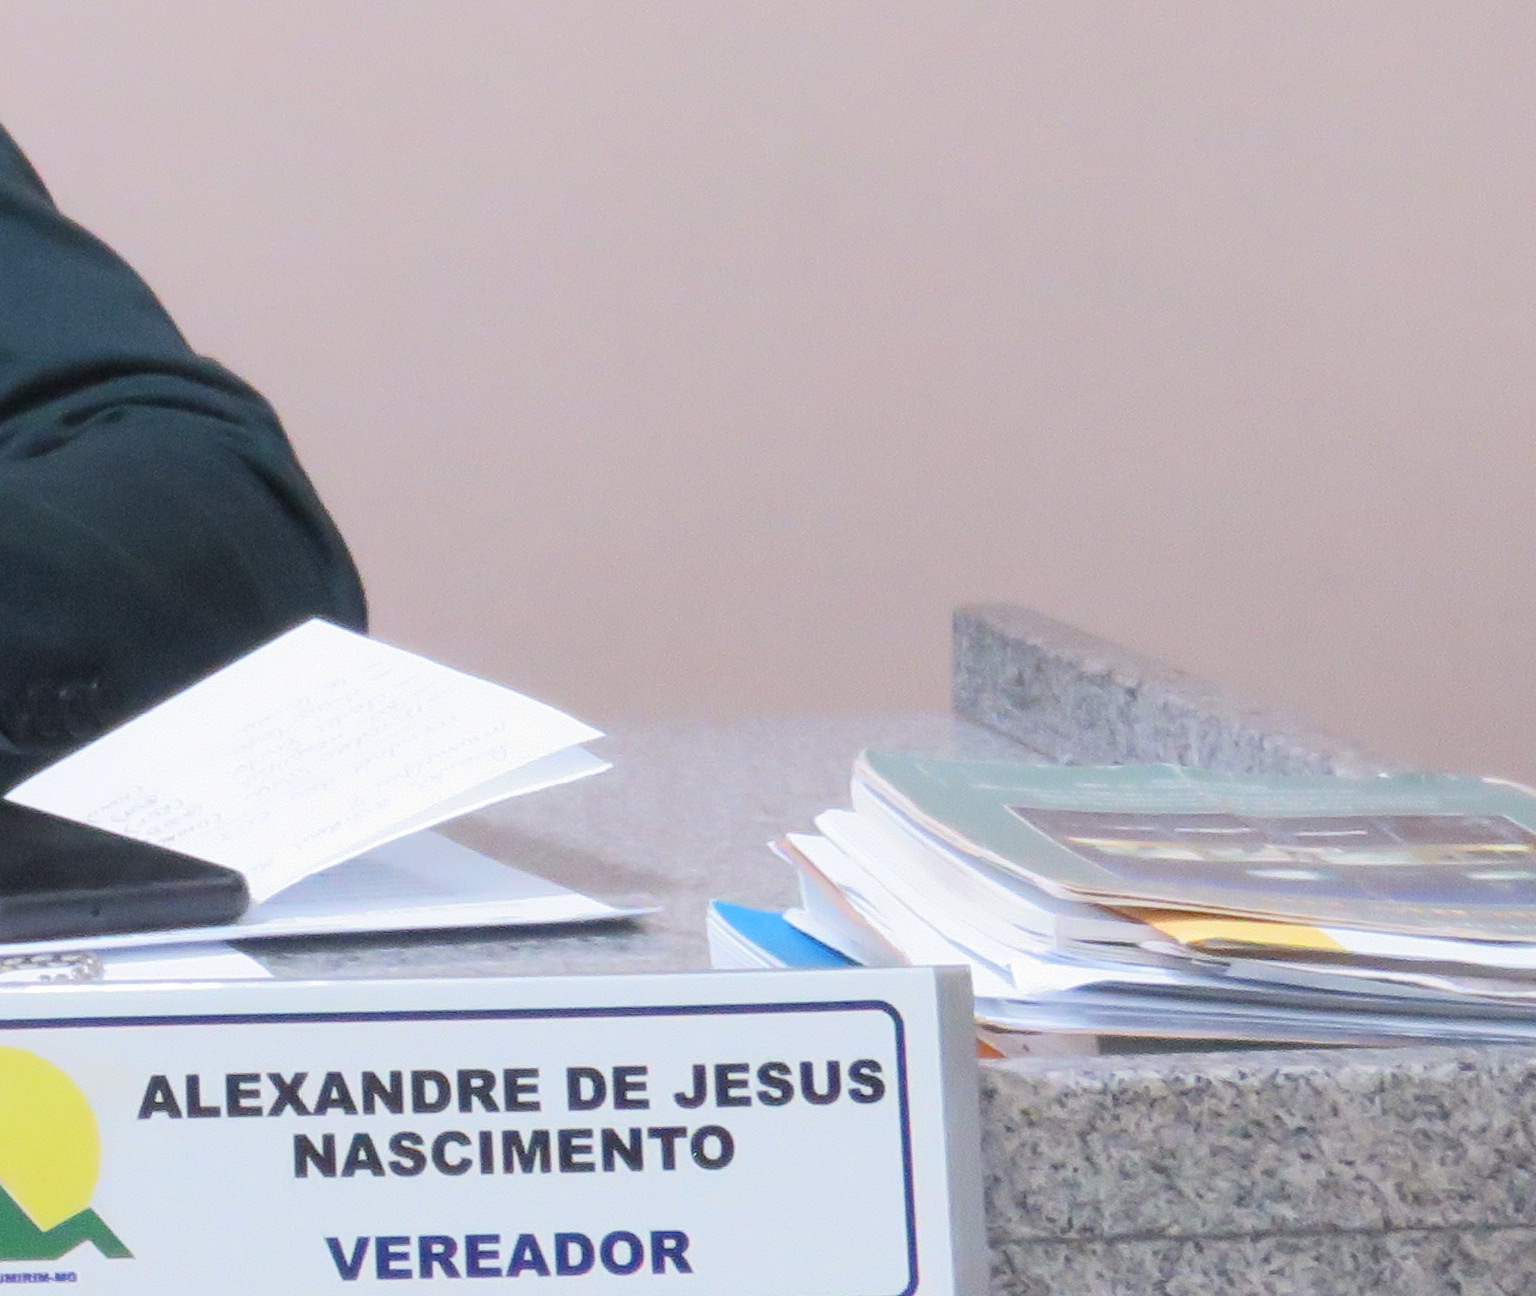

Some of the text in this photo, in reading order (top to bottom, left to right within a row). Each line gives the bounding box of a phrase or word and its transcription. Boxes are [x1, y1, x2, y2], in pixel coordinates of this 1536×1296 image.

[138, 1059, 886, 1119] ALEXANDRE DE JESUS
[293, 1125, 735, 1178] NASCIMENTO
[326, 1230, 693, 1281] VEREADOR
